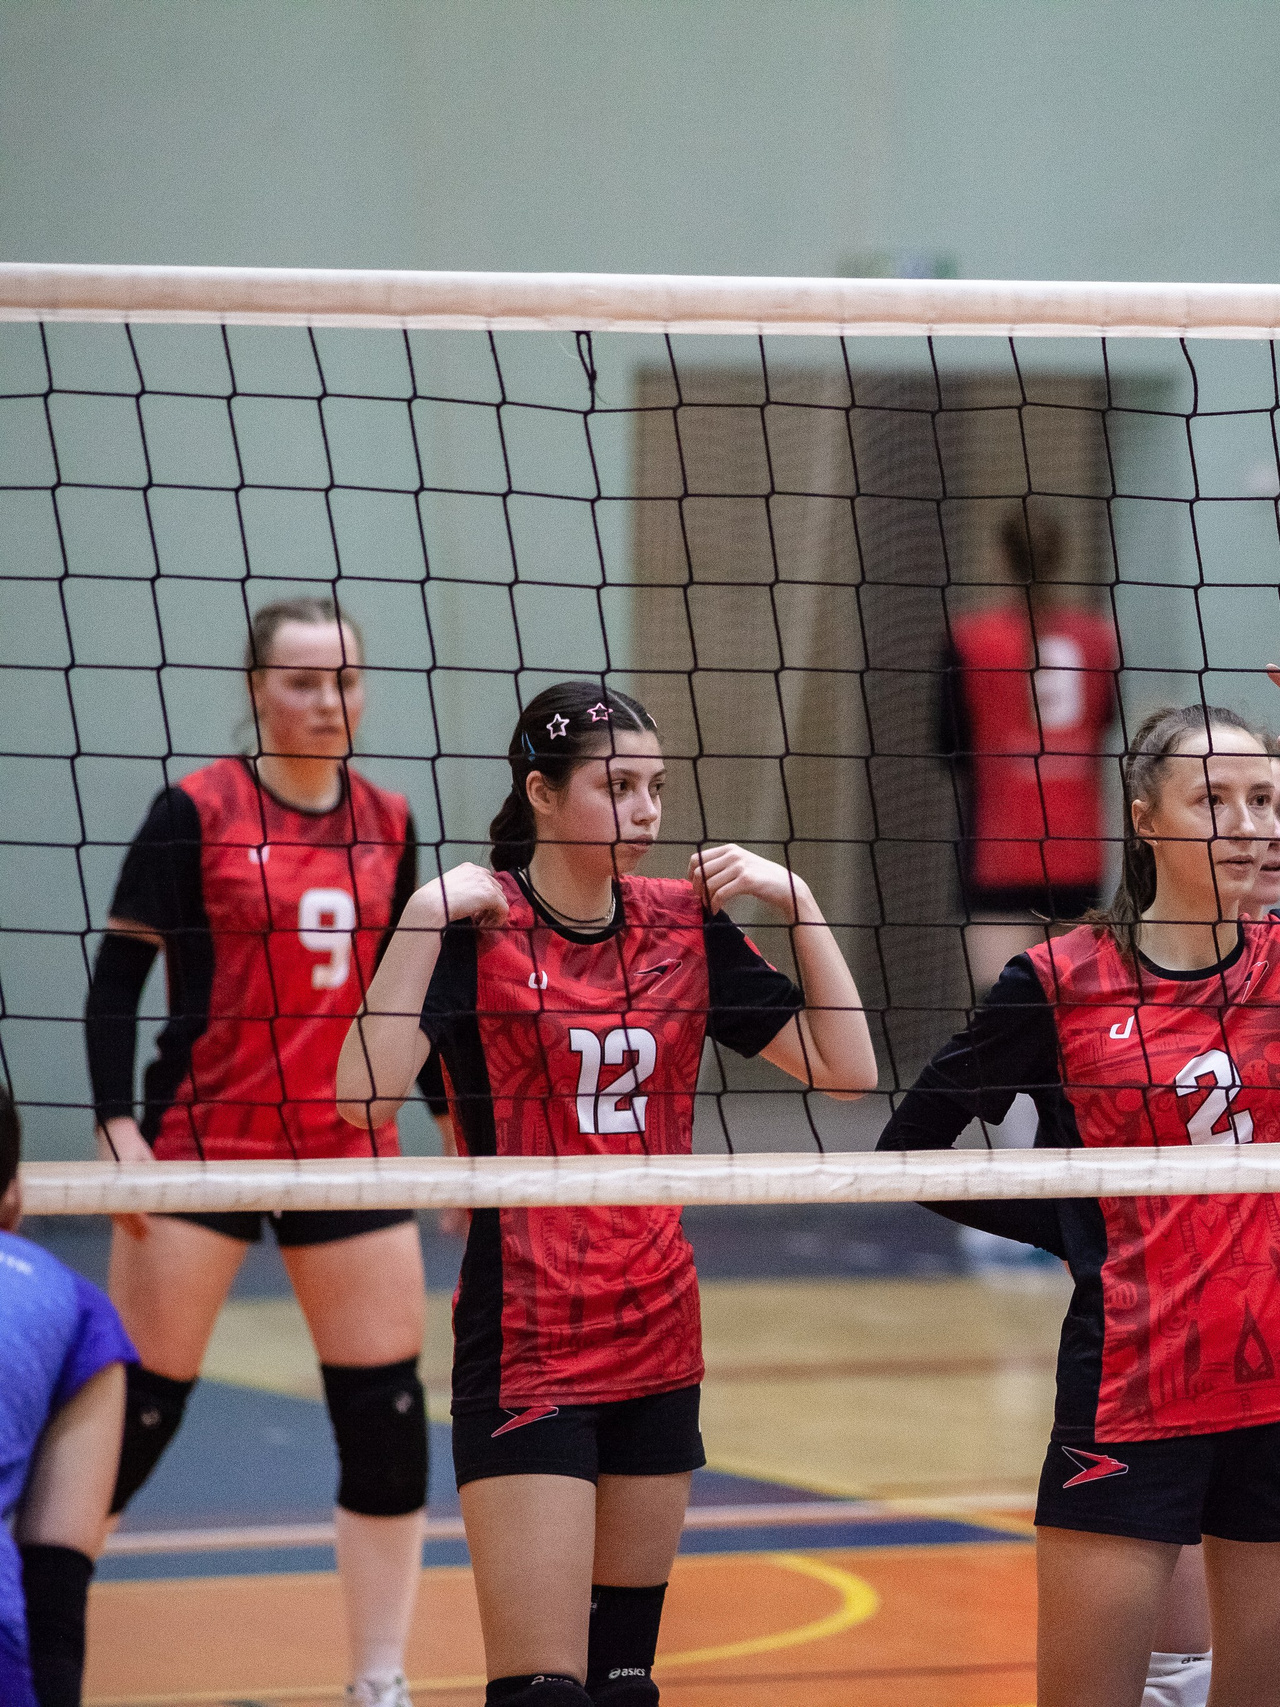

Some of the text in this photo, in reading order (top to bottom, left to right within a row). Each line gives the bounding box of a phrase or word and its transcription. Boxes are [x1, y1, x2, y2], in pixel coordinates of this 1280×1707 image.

[298, 887, 355, 989] 9
[569, 1027, 657, 1134] 12
[1175, 1048, 1254, 1145] 2
[620, 1667, 646, 1677] asics
